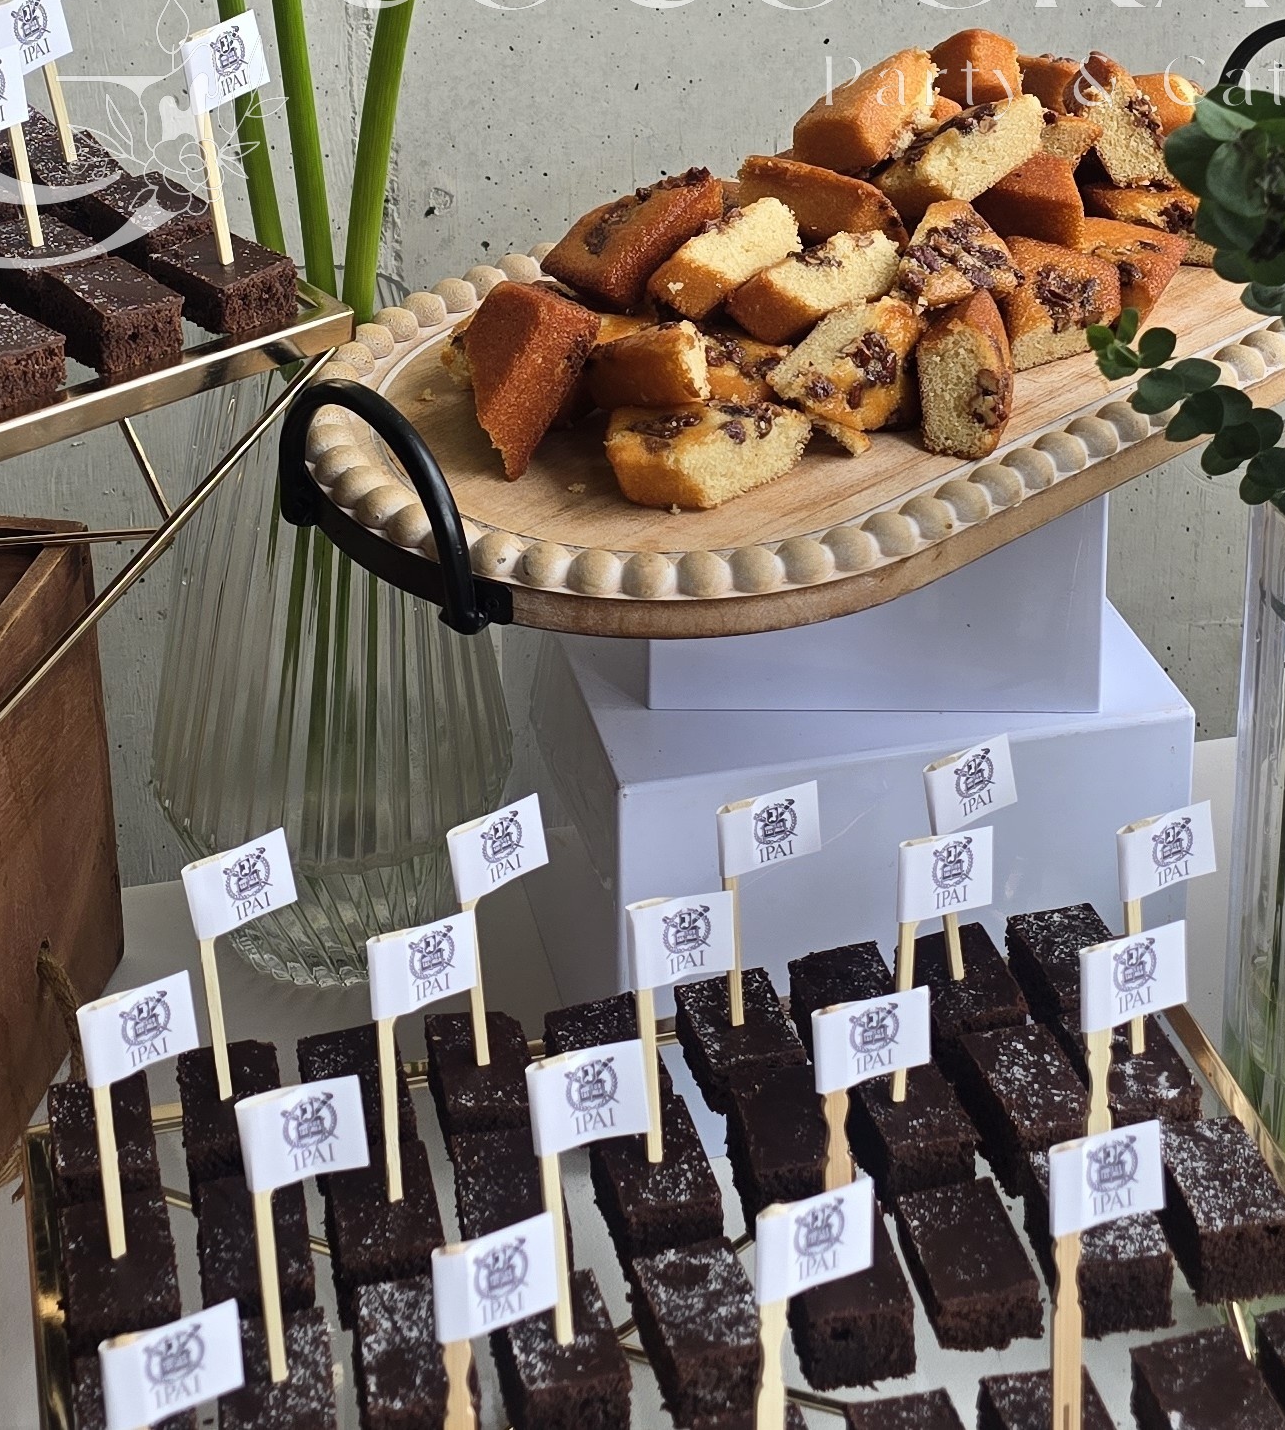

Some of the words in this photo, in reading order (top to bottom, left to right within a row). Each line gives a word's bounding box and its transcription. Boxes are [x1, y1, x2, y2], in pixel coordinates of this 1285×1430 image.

[23, 38, 51, 65] IPAI
[221, 70, 248, 96] IPAI
[963, 790, 993, 816] IPAI
[760, 840, 793, 862] IPAI
[491, 854, 522, 882] IPAI
[1158, 860, 1190, 885] IPAI
[237, 892, 271, 920] IPAI
[936, 885, 968, 909] IPAI
[670, 950, 705, 974] IPAI
[416, 972, 450, 1001] IPAI
[1119, 986, 1152, 1014] IPAI
[131, 1037, 168, 1067] IPAI
[856, 1049, 894, 1074] IPAI
[575, 1108, 616, 1135] IPAI
[293, 1143, 335, 1170] IPAI
[1093, 1187, 1133, 1214] IPAI
[799, 1249, 838, 1280] IPAI
[482, 1294, 525, 1324] IPAI
